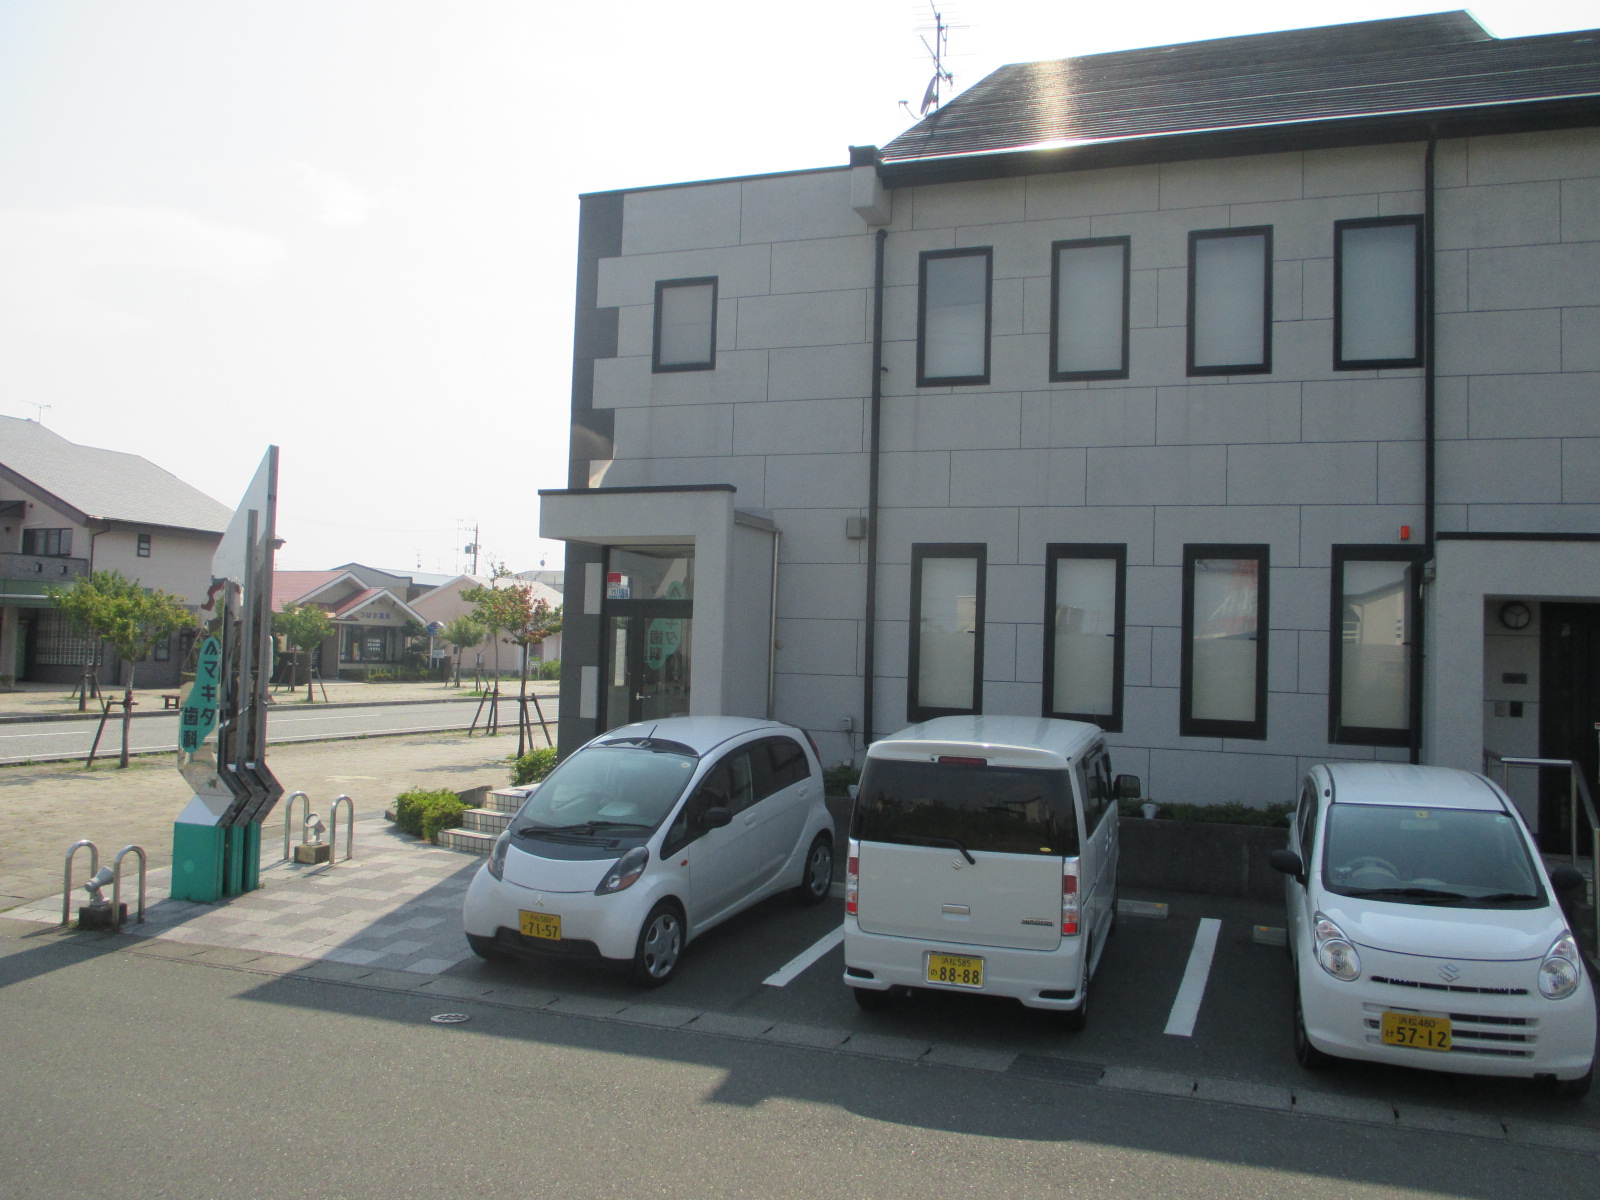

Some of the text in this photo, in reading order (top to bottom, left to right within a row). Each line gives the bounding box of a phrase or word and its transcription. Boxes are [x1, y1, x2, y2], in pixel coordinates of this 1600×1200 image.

[183, 706, 199, 748] 歯科
[529, 922, 558, 938] 71-57
[940, 967, 979, 985] 88-88
[1397, 1026, 1447, 1048] 57-12
